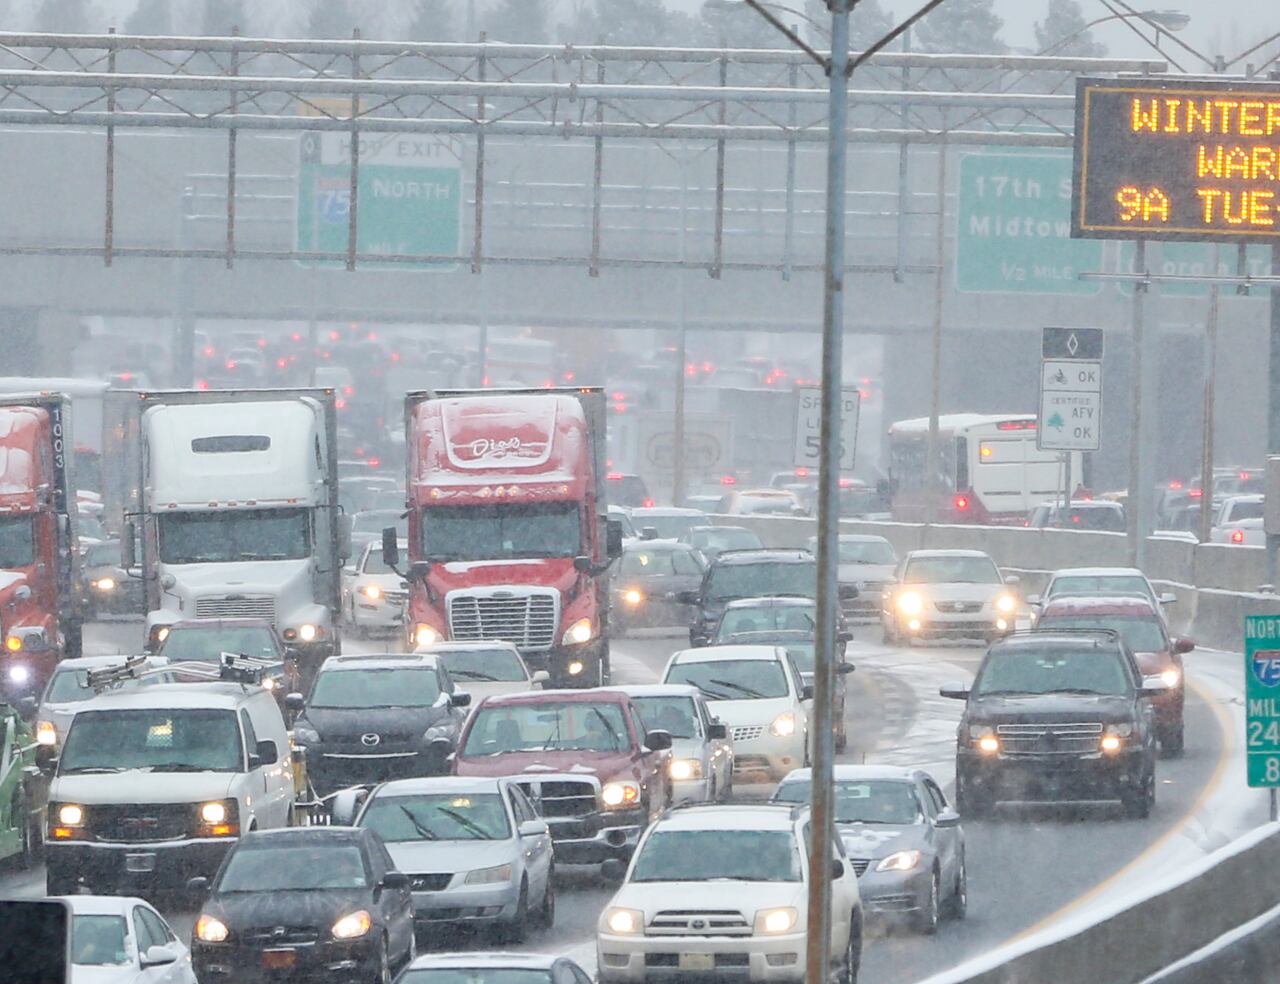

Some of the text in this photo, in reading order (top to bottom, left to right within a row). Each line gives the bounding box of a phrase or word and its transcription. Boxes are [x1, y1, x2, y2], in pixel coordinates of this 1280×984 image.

[397, 141, 442, 157] EXIT
[373, 178, 450, 199] NORTH
[975, 176, 1073, 199] 17th S
[321, 189, 351, 215] 75
[1117, 187, 1171, 223] 9A
[969, 215, 1072, 237] Midtow
[1034, 265, 1073, 281] MILE
[1078, 372, 1097, 383] OK
[801, 395, 855, 413] SPD
[1071, 407, 1094, 418] AFV
[52, 409, 64, 469] 1003
[1073, 427, 1092, 439] OK
